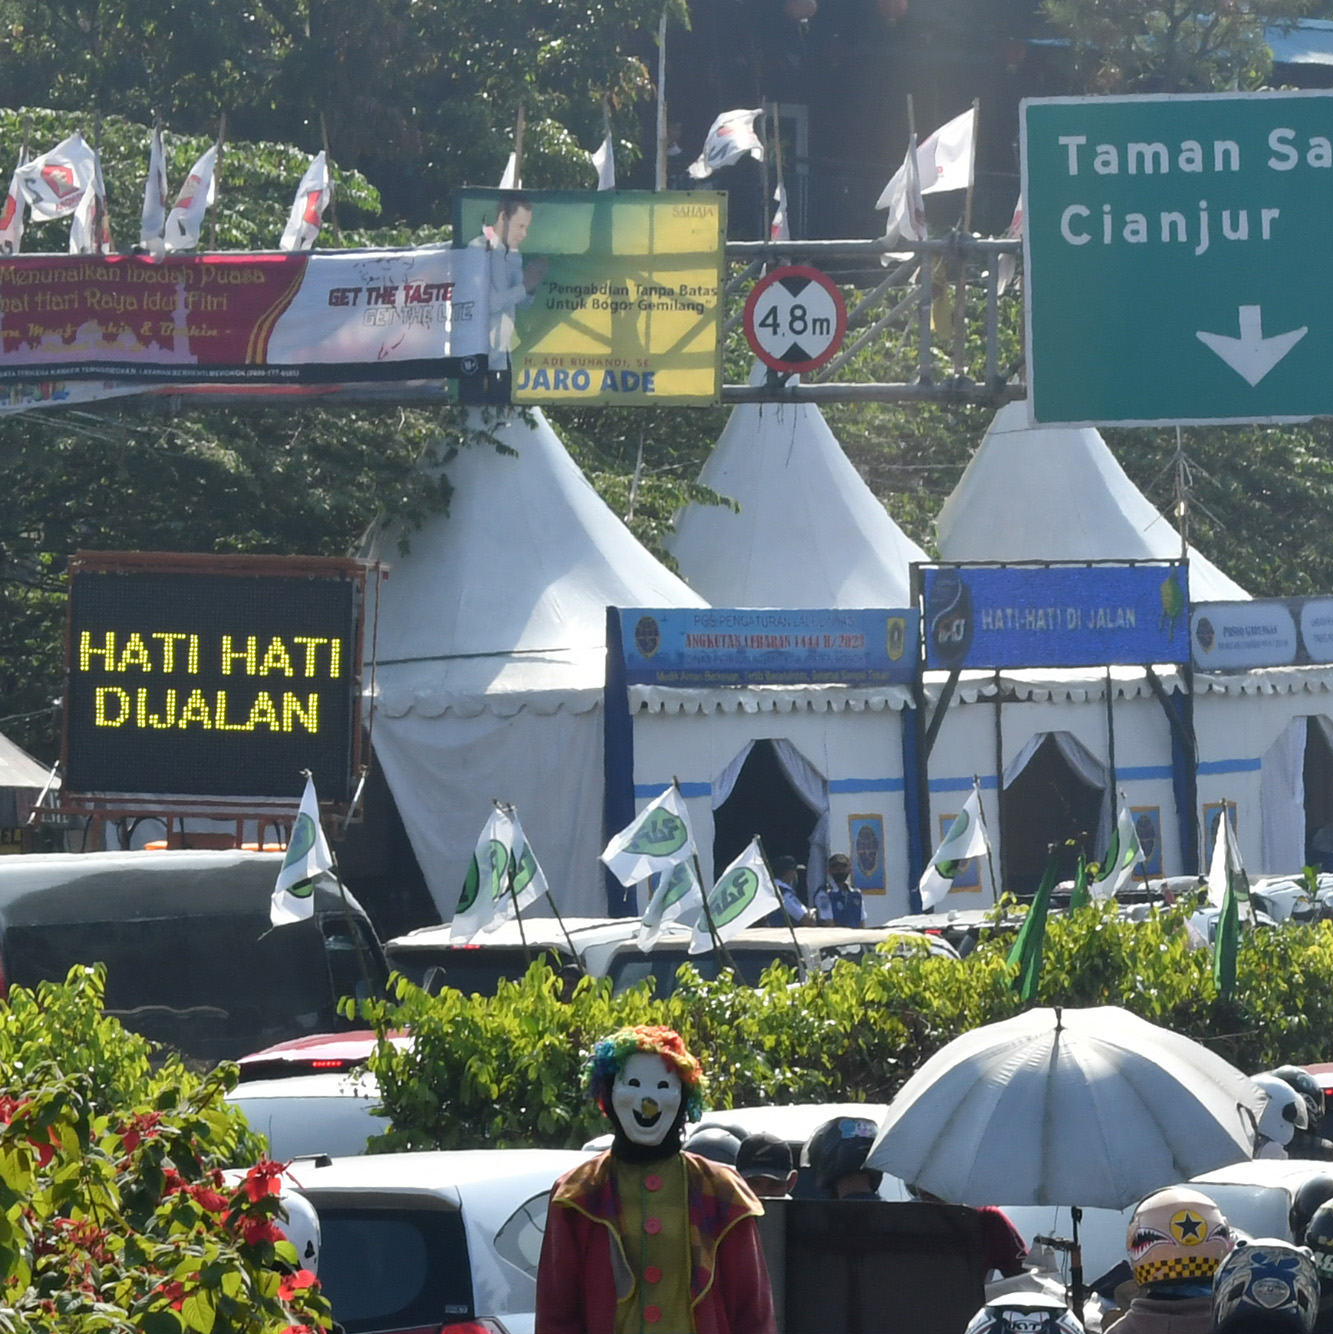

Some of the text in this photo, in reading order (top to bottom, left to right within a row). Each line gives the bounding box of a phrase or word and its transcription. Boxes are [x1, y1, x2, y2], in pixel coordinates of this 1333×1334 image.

[1058, 135, 1241, 176] Taman
[672, 205, 714, 218] SAHAJA
[1060, 204, 1281, 256] Cianjur
[127, 264, 194, 284] Ibadah
[200, 265, 266, 286] Puasa
[39, 292, 79, 311] Hari
[84, 288, 137, 315] Raya
[328, 281, 455, 307] GET THE TASTE
[633, 283, 675, 299] Tanpa
[679, 283, 718, 297] Batas
[362, 304, 398, 326] GET
[401, 303, 433, 325] THE
[546, 298, 587, 311] Untuk
[592, 298, 632, 314] Bogor
[542, 357, 565, 367] ADE
[517, 368, 656, 393] JARO ADE
[981, 607, 1061, 630] HATI-HATI
[1088, 607, 1136, 630] JALAN
[685, 634, 741, 649] ANGKUTAN
[79, 630, 341, 678] HATI HATI
[95, 686, 319, 733] DIJALAN
